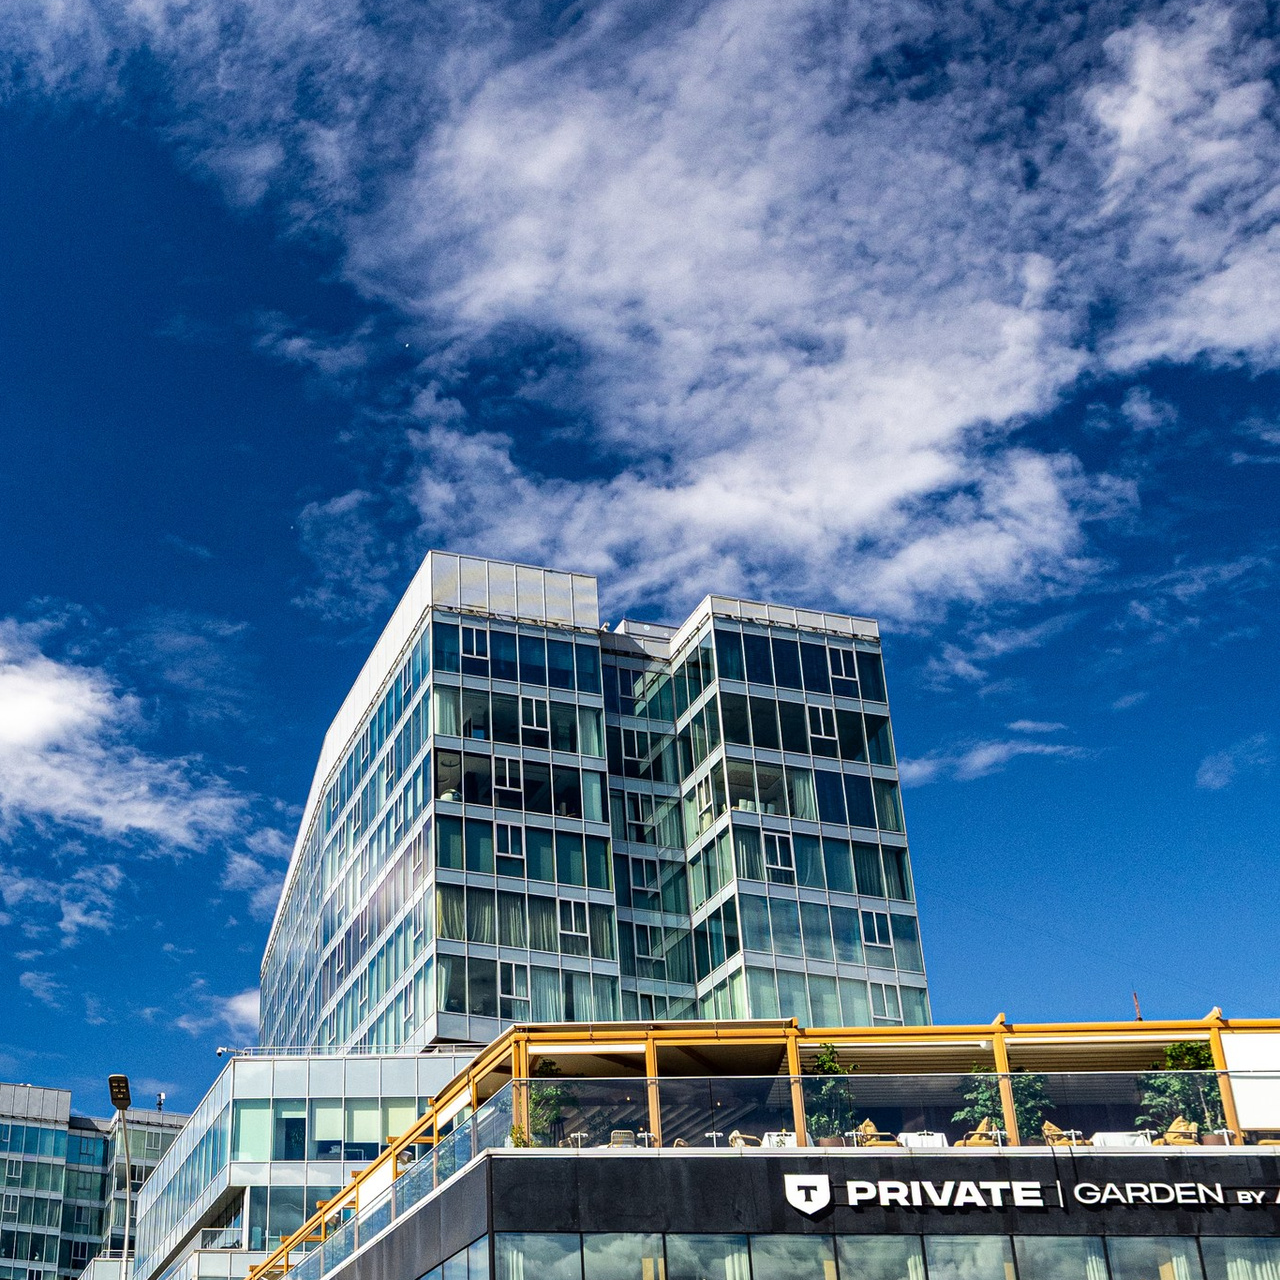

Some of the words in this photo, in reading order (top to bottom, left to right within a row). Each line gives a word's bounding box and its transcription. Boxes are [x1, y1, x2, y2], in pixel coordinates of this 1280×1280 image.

[846, 1180, 1044, 1207] PRIVATE
[1073, 1182, 1225, 1205] GARDEN
[1236, 1190, 1266, 1205] BY
